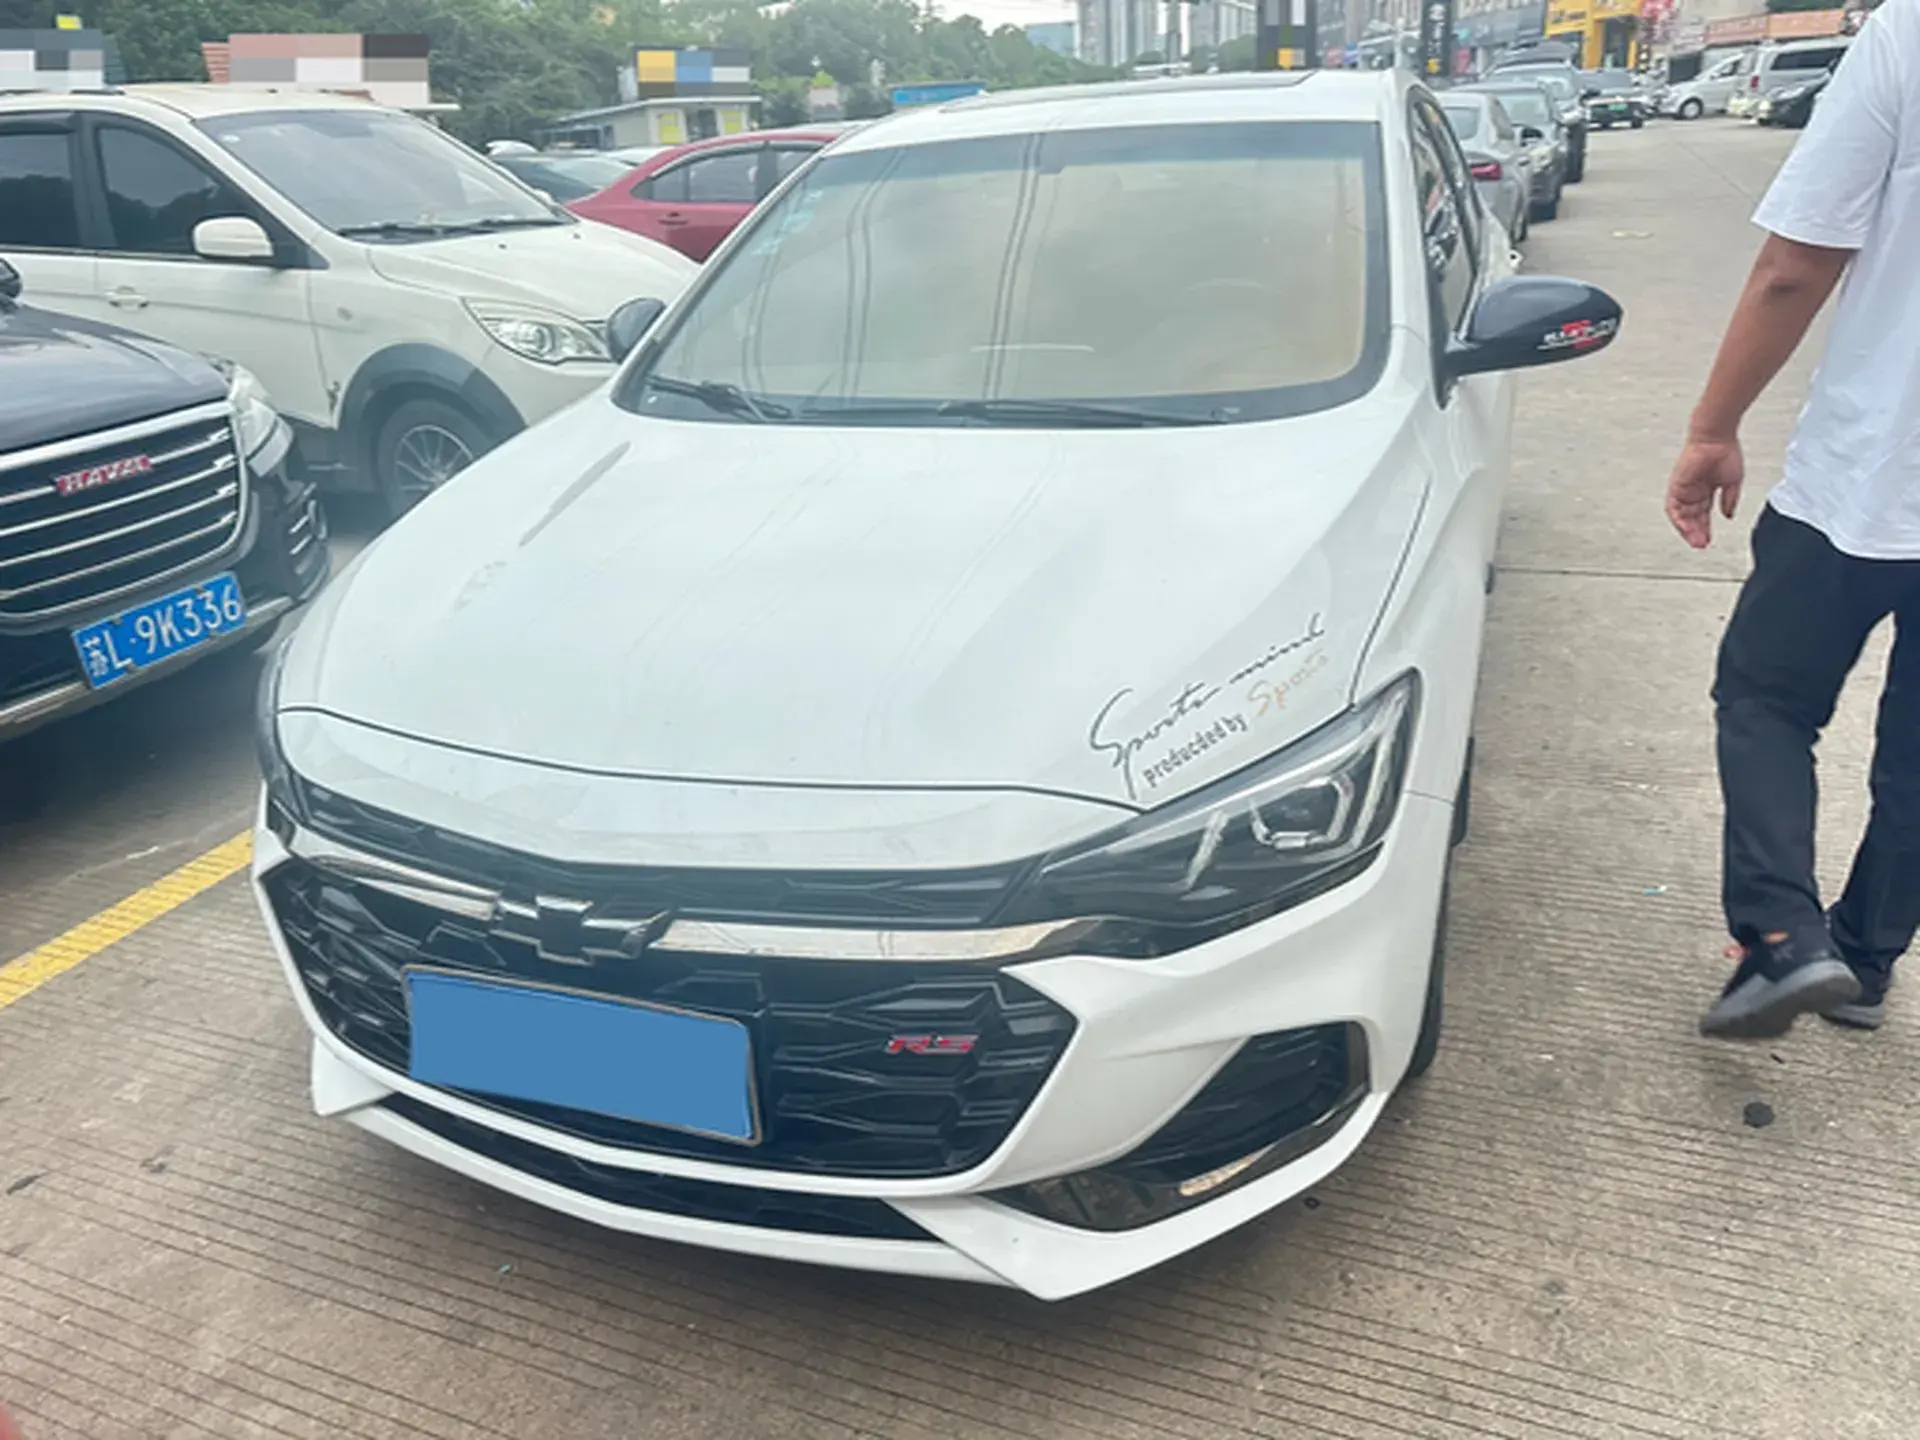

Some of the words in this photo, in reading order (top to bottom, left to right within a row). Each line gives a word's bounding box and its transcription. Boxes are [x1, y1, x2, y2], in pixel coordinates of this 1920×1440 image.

[57, 454, 151, 495] HAVAL
[1089, 682, 1222, 801] Sports
[1230, 611, 1326, 685] mind
[1220, 713, 1248, 733] by
[884, 1034, 980, 1055] RS
